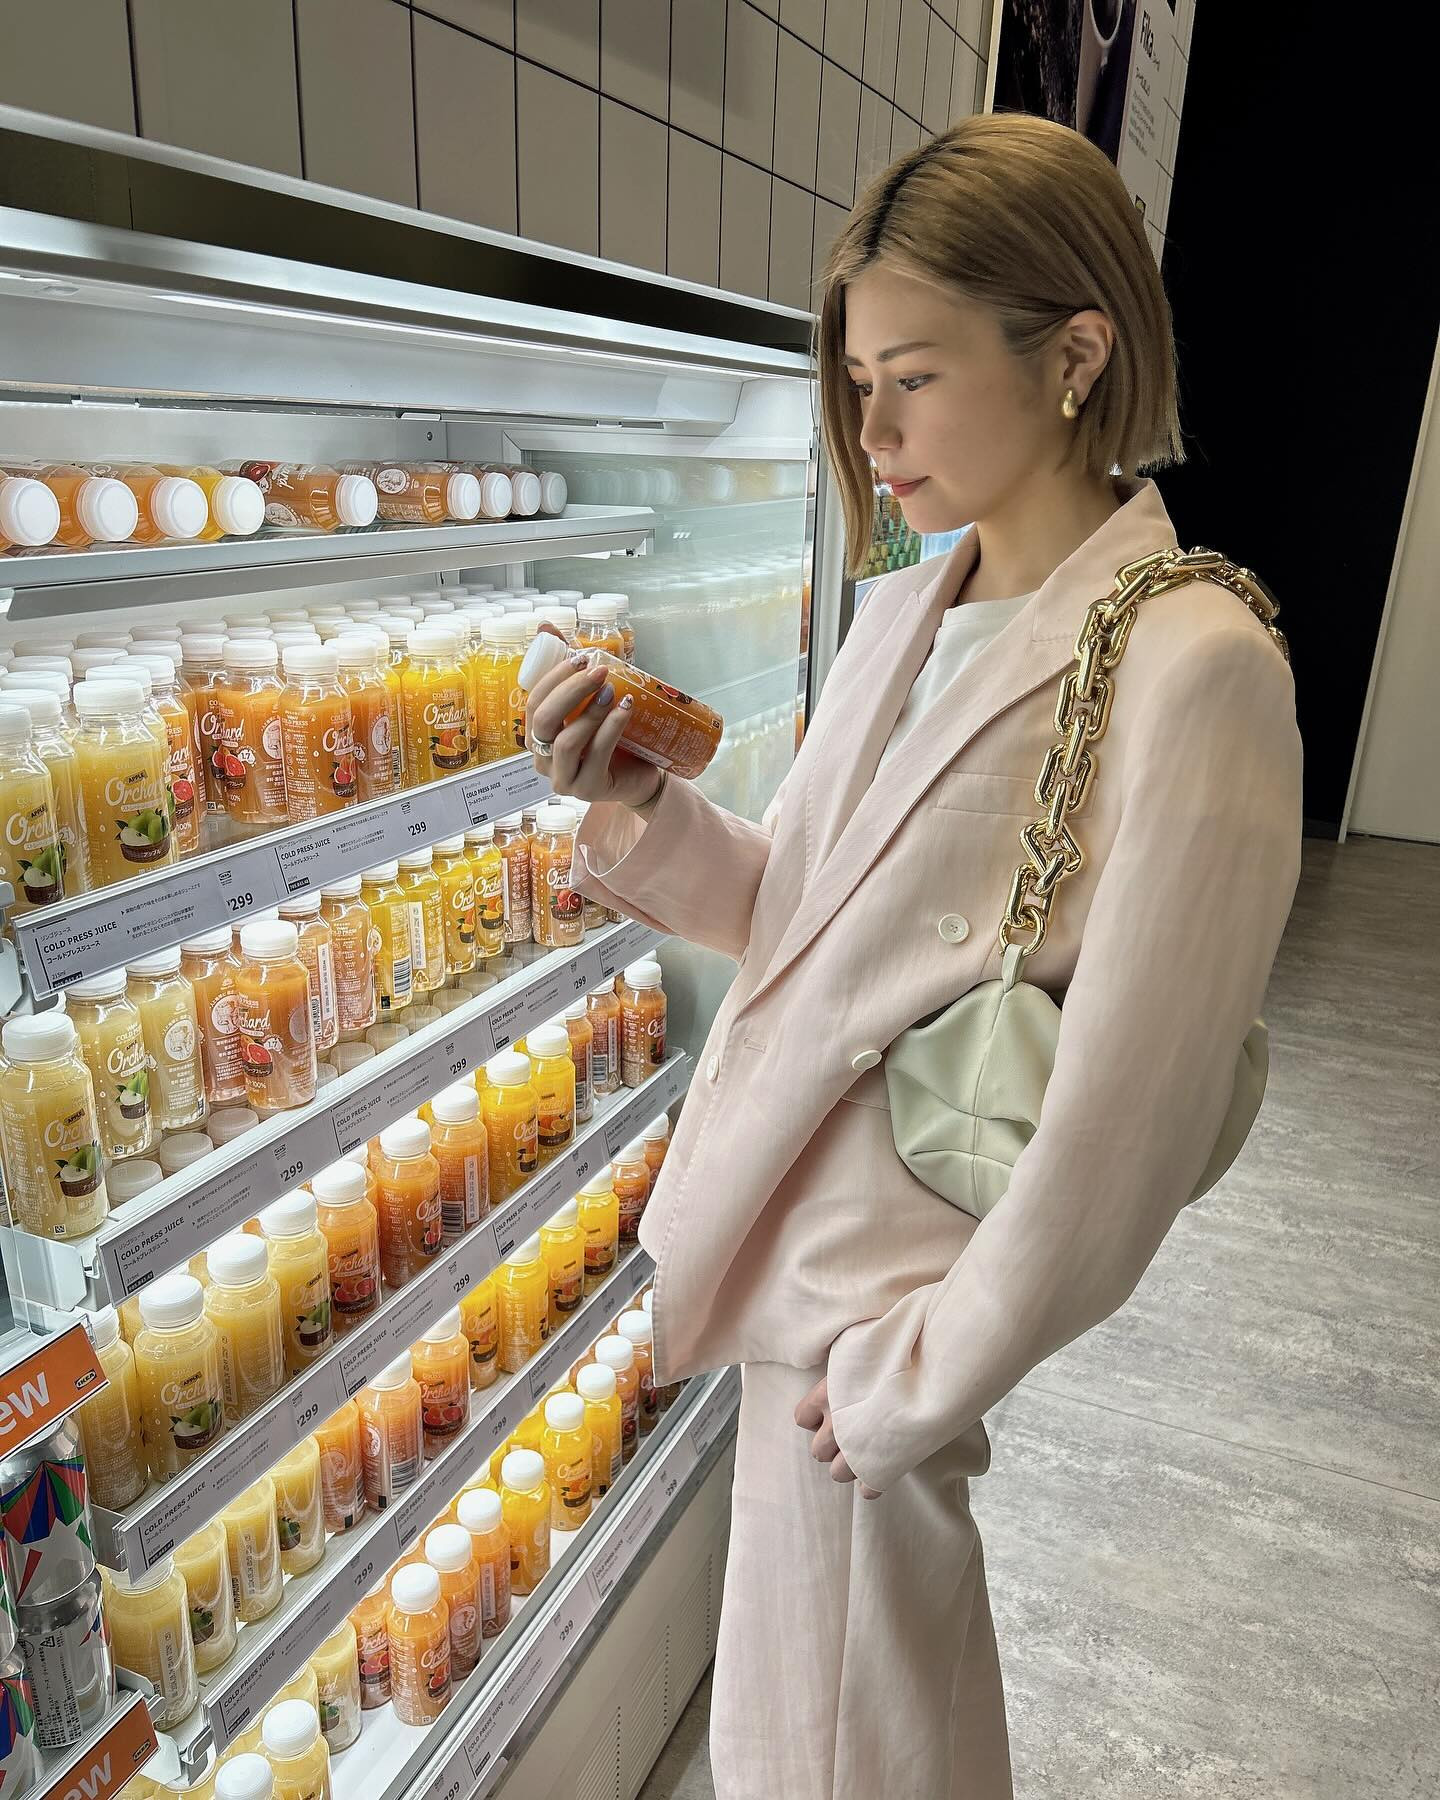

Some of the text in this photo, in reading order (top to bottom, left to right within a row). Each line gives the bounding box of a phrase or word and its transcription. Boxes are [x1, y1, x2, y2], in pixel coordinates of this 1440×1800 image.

[127, 771, 146, 785] APPLE
[466, 789, 478, 800] COLD
[477, 785, 490, 796] PRESS
[490, 781, 501, 791] JUICE
[30, 803, 47, 818] APPLE
[407, 820, 428, 836] ¥299
[280, 850, 297, 860] COLD
[296, 843, 314, 855] PRESS
[314, 837, 331, 849] JUICE
[226, 892, 254, 913] ¥299
[43, 921, 118, 954] COLD PRESS JUICE
[46, 940, 101, 965] コールドプレスジュース
[337, 1095, 382, 1128] COLD PRESS JUICE
[281, 1160, 304, 1183] ¥299
[121, 1216, 185, 1261] COLD PRESS JUICE
[343, 1329, 387, 1370] COLD PRESS JUICE
[76, 1371, 96, 1389] IKEA
[297, 1403, 319, 1427] ¥299
[144, 1481, 206, 1536] COLD PRESS JUICE
[223, 1649, 276, 1708] COLD PRESS JUICE
